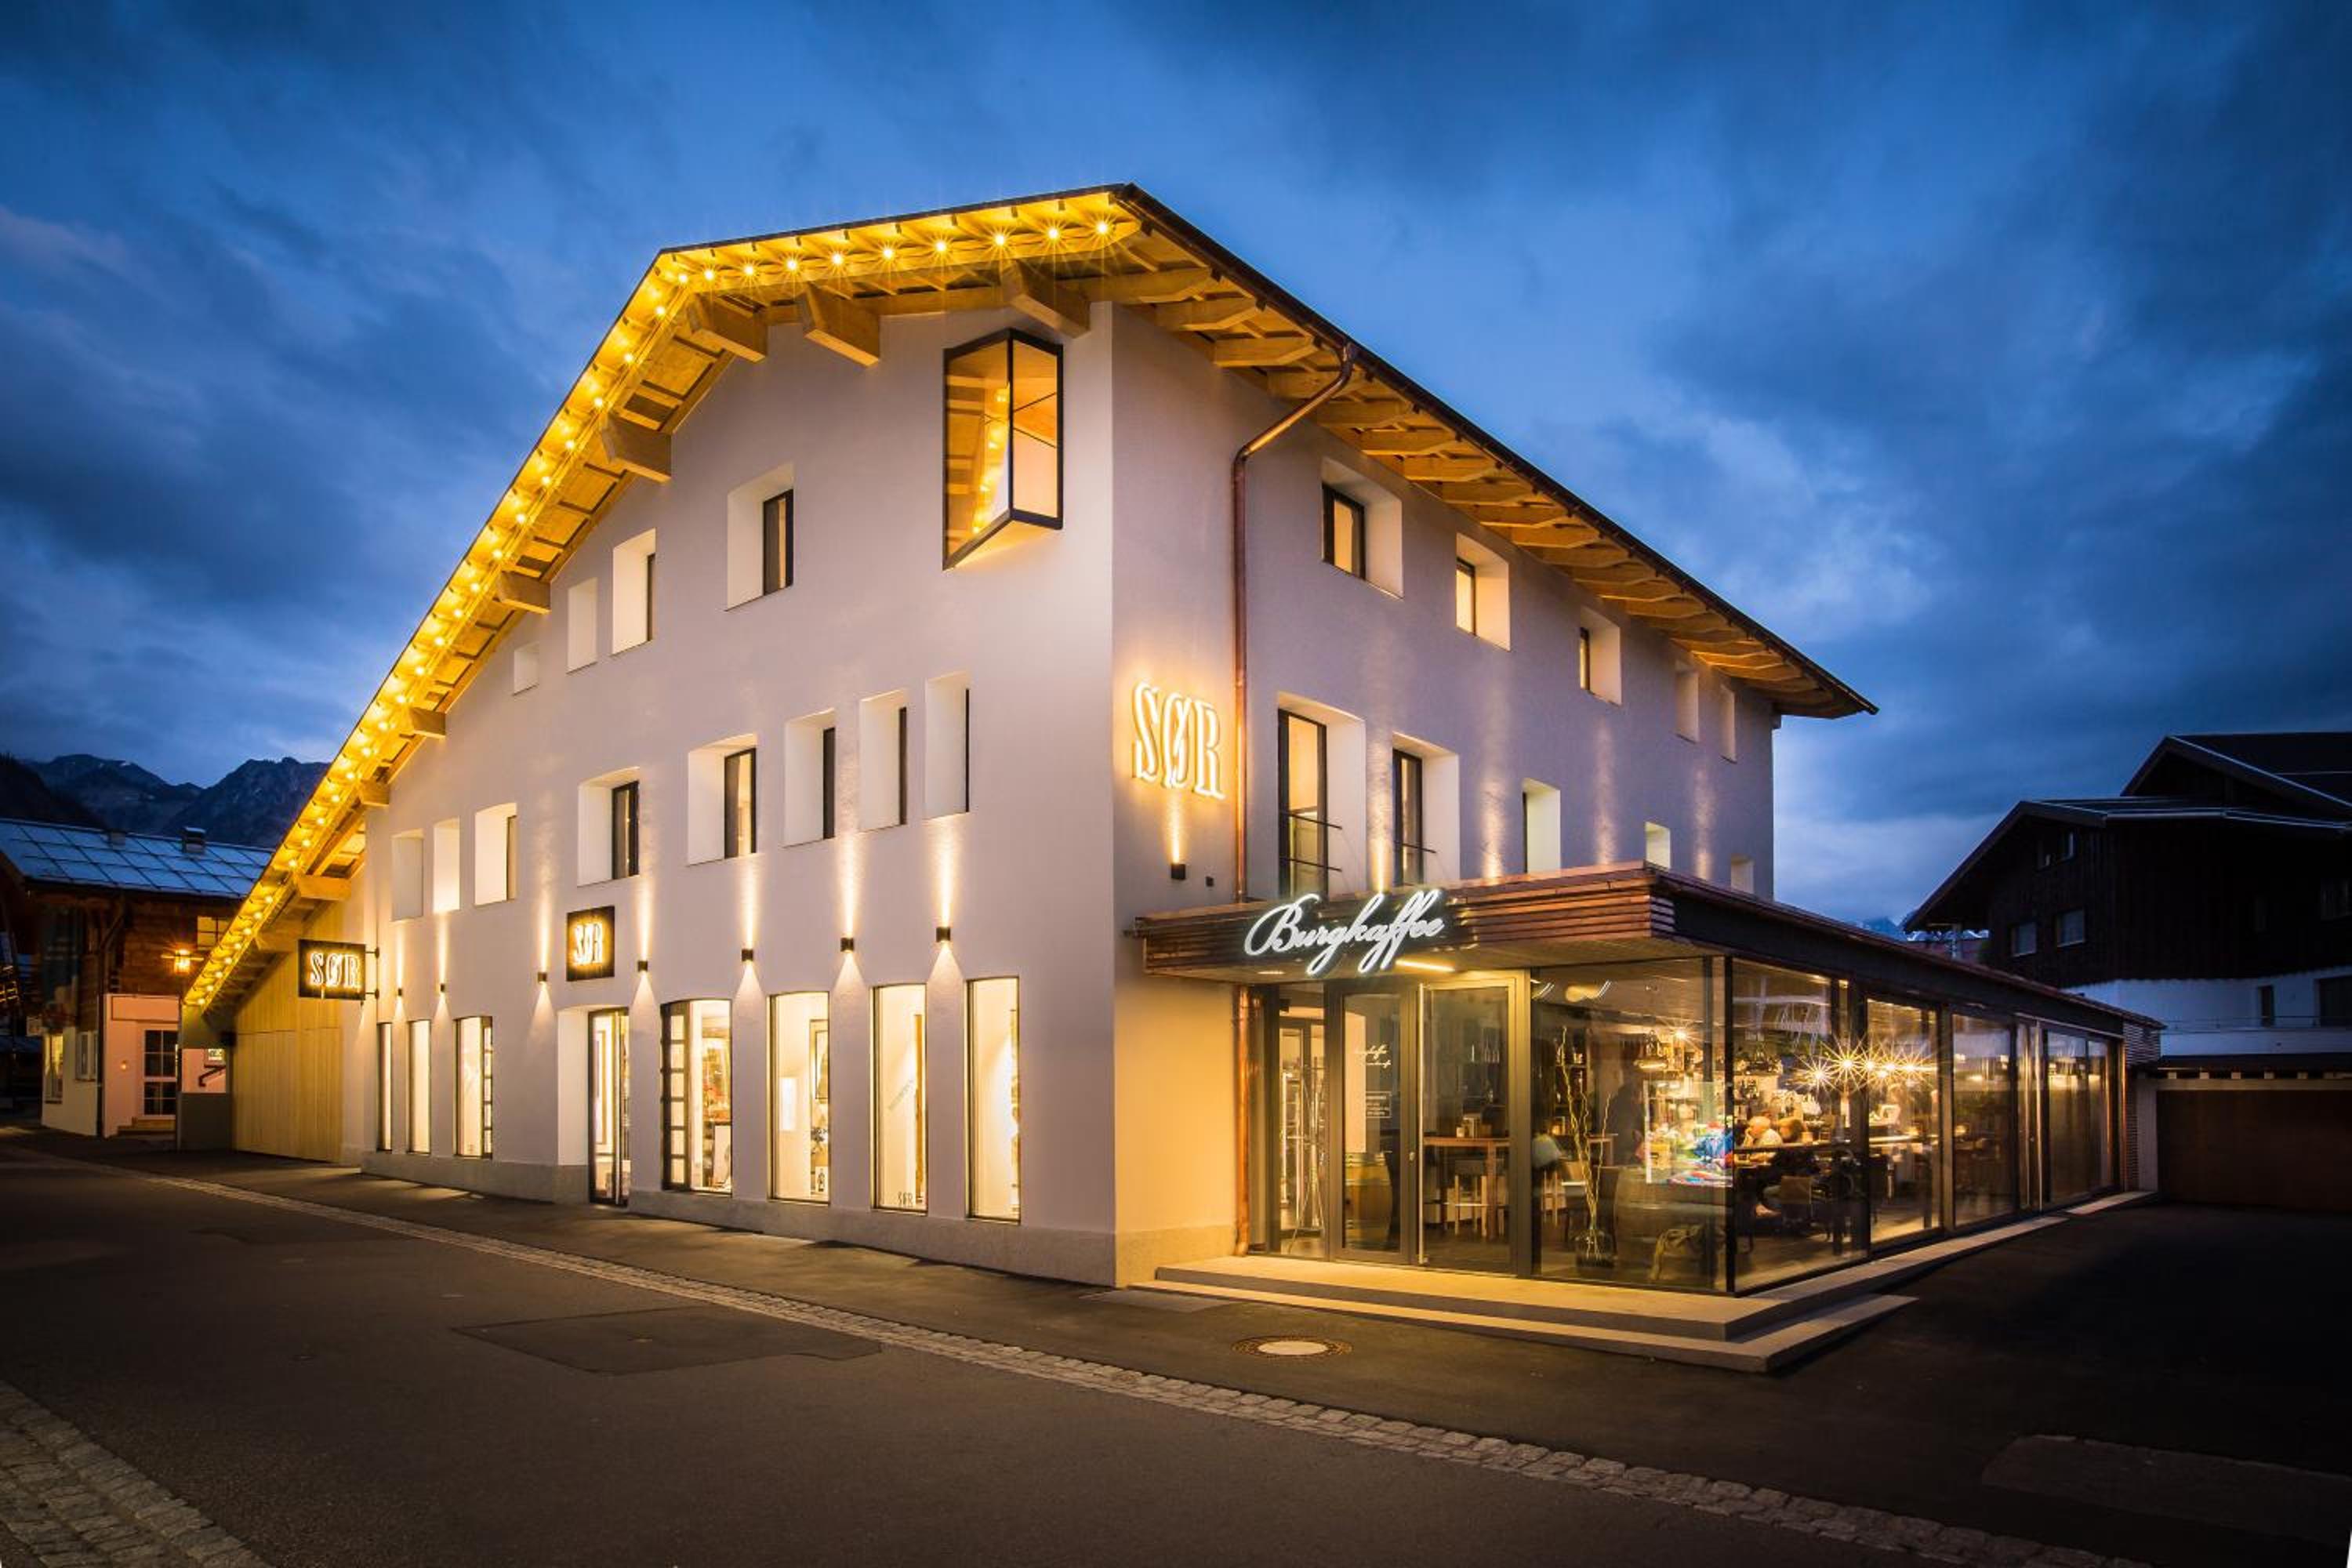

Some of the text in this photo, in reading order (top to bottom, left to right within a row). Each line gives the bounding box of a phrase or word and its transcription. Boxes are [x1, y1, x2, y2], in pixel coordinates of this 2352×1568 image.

[1133, 681, 1225, 800] SØR
[574, 923, 603, 965] SØR
[310, 951, 361, 990] SØR
